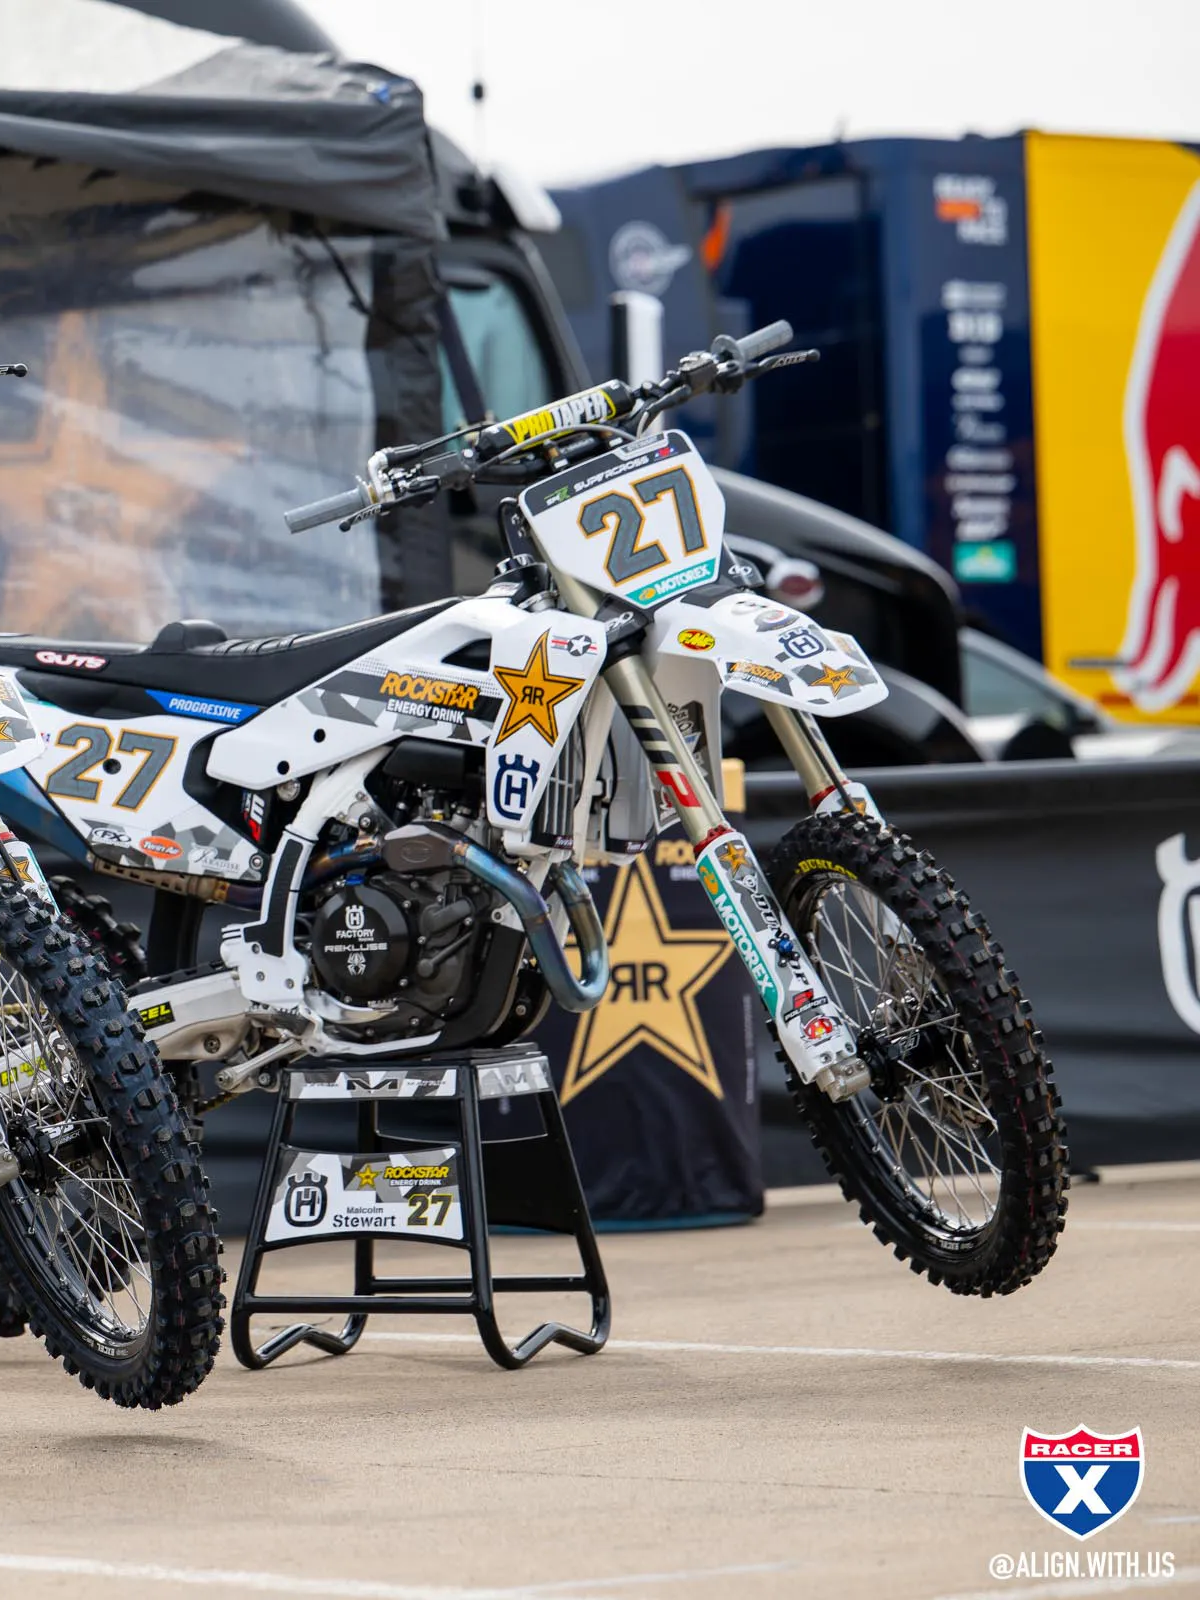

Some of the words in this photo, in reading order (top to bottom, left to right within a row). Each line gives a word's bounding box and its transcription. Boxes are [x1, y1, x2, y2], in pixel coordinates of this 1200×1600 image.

[573, 456, 650, 492] SUPERCROSS
[576, 463, 710, 587] 27
[654, 565, 711, 595] MOTOREX
[678, 630, 716, 650] FMF
[36, 651, 106, 669] GUTS
[380, 672, 479, 711] ROCKSTAR
[169, 697, 242, 720] PROGRESSIVE
[387, 699, 432, 719] ENERGY
[432, 709, 464, 725] DRINK
[45, 722, 179, 814] 27
[336, 928, 375, 939] FACTORY
[714, 896, 775, 994] MOTOREX
[324, 942, 388, 952] REKLUSE
[139, 1004, 171, 1021] CEL
[384, 1166, 450, 1179] ROCKSTAR
[332, 1214, 398, 1229] Stewart
[346, 1206, 384, 1215] Malcolm
[407, 1193, 453, 1227] 27
